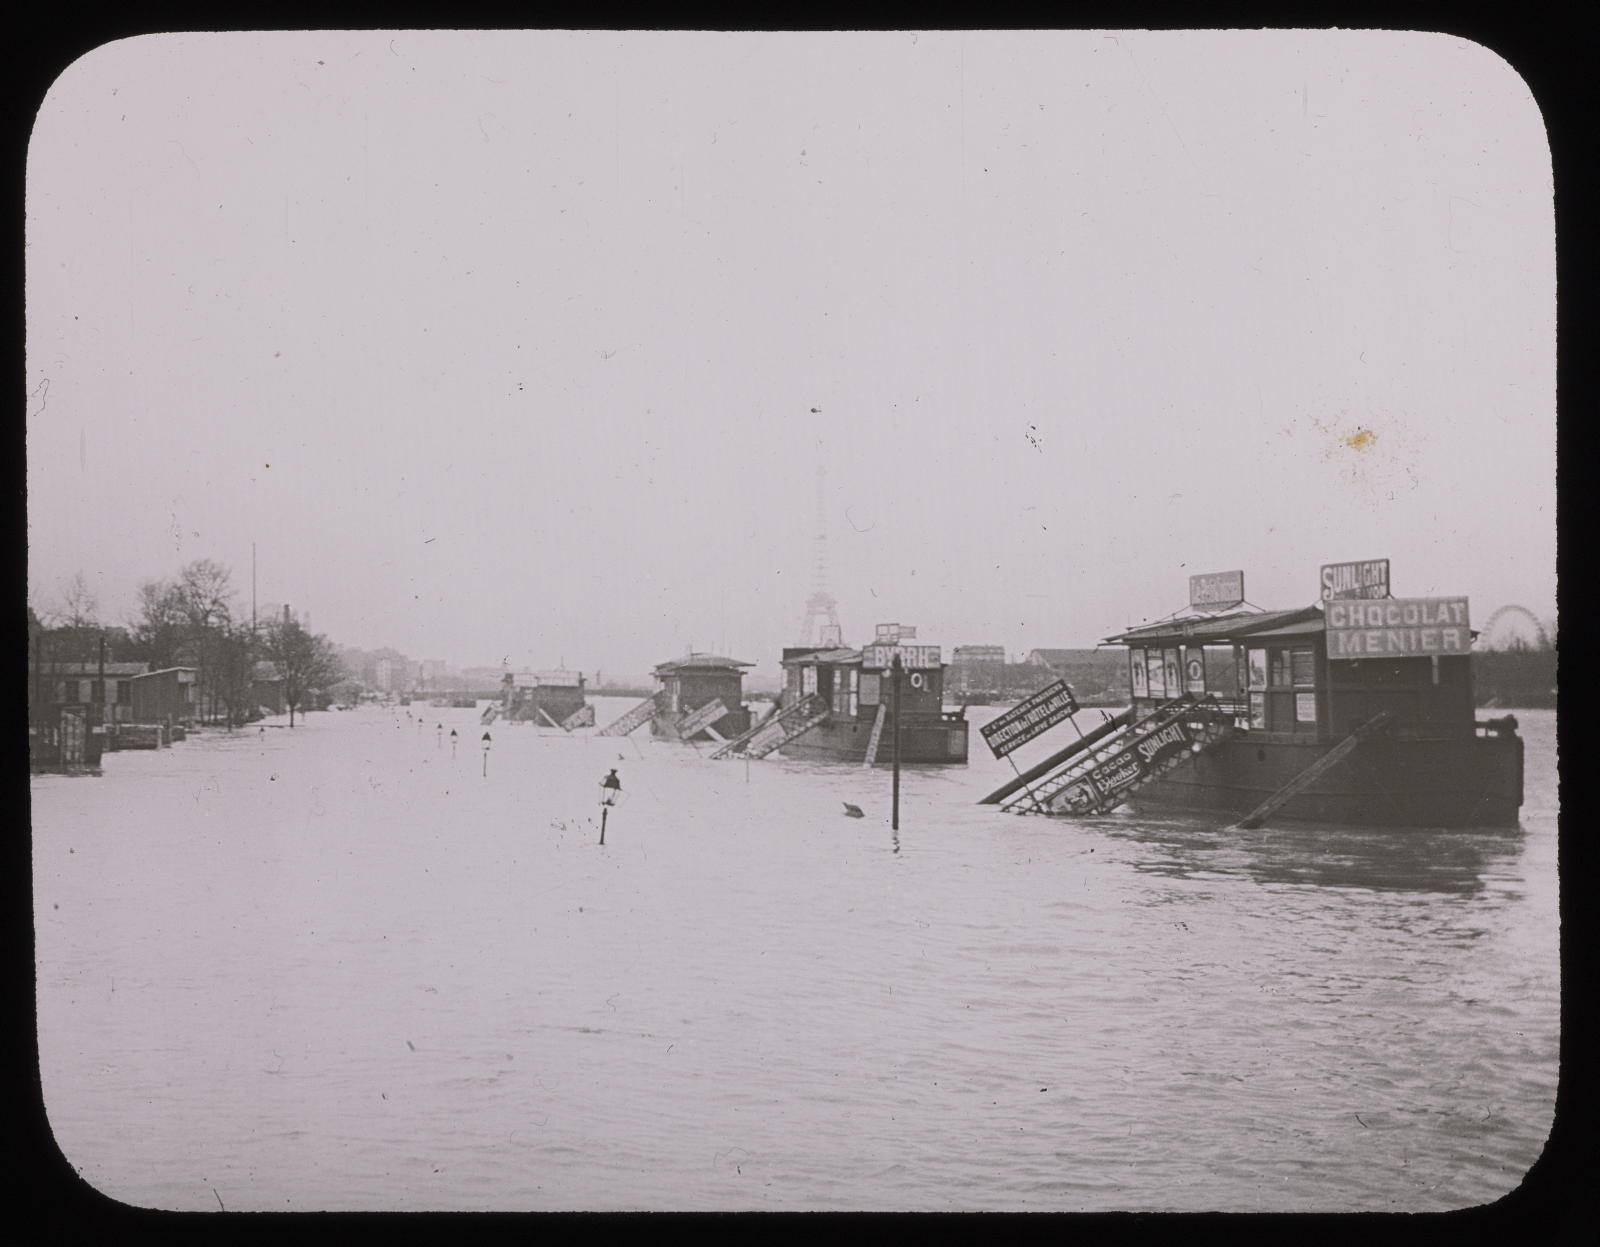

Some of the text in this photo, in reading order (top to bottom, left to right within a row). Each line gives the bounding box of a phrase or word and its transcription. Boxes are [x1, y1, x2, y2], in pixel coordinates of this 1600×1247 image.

[1322, 561, 1387, 600] SUNLIGHT
[1330, 602, 1465, 627] CHOCOLAT
[1338, 628, 1461, 653] MENIER
[875, 647, 928, 669] BYRRH
[987, 720, 1022, 748] DIRECTION
[1051, 690, 1071, 709] VILLE
[1138, 722, 1187, 763] SUNLIGHT
[1096, 762, 1139, 795] Blooker
